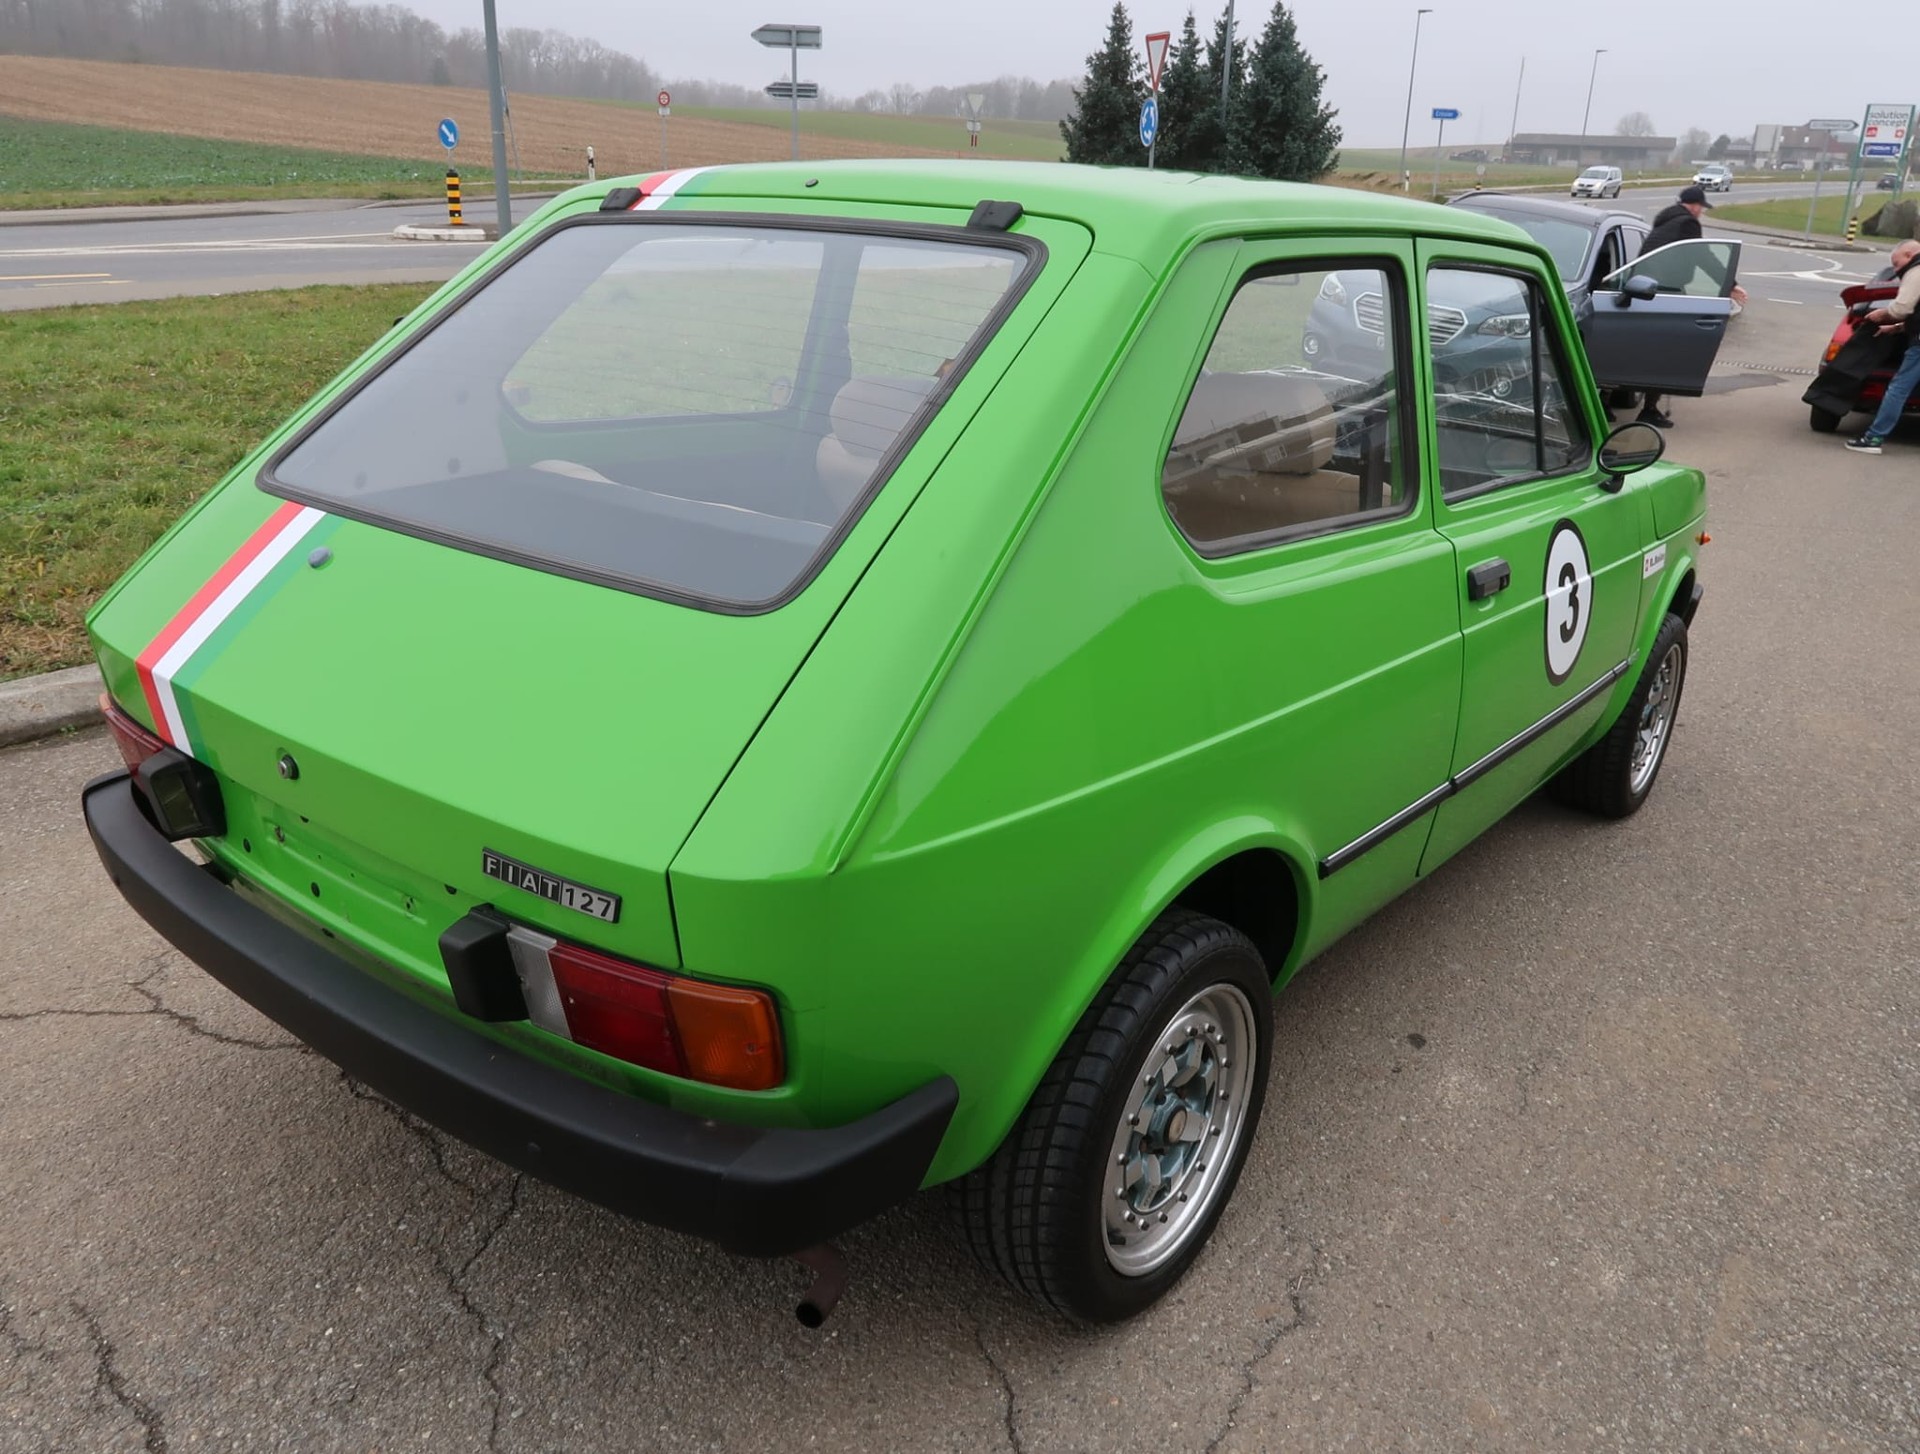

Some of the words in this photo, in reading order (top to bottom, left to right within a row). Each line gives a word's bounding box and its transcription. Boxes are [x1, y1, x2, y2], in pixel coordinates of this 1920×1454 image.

[1869, 110, 1909, 119] solution
[1558, 562, 1580, 643] 3
[486, 856, 558, 898] FIAT
[565, 888, 612, 918] 127
